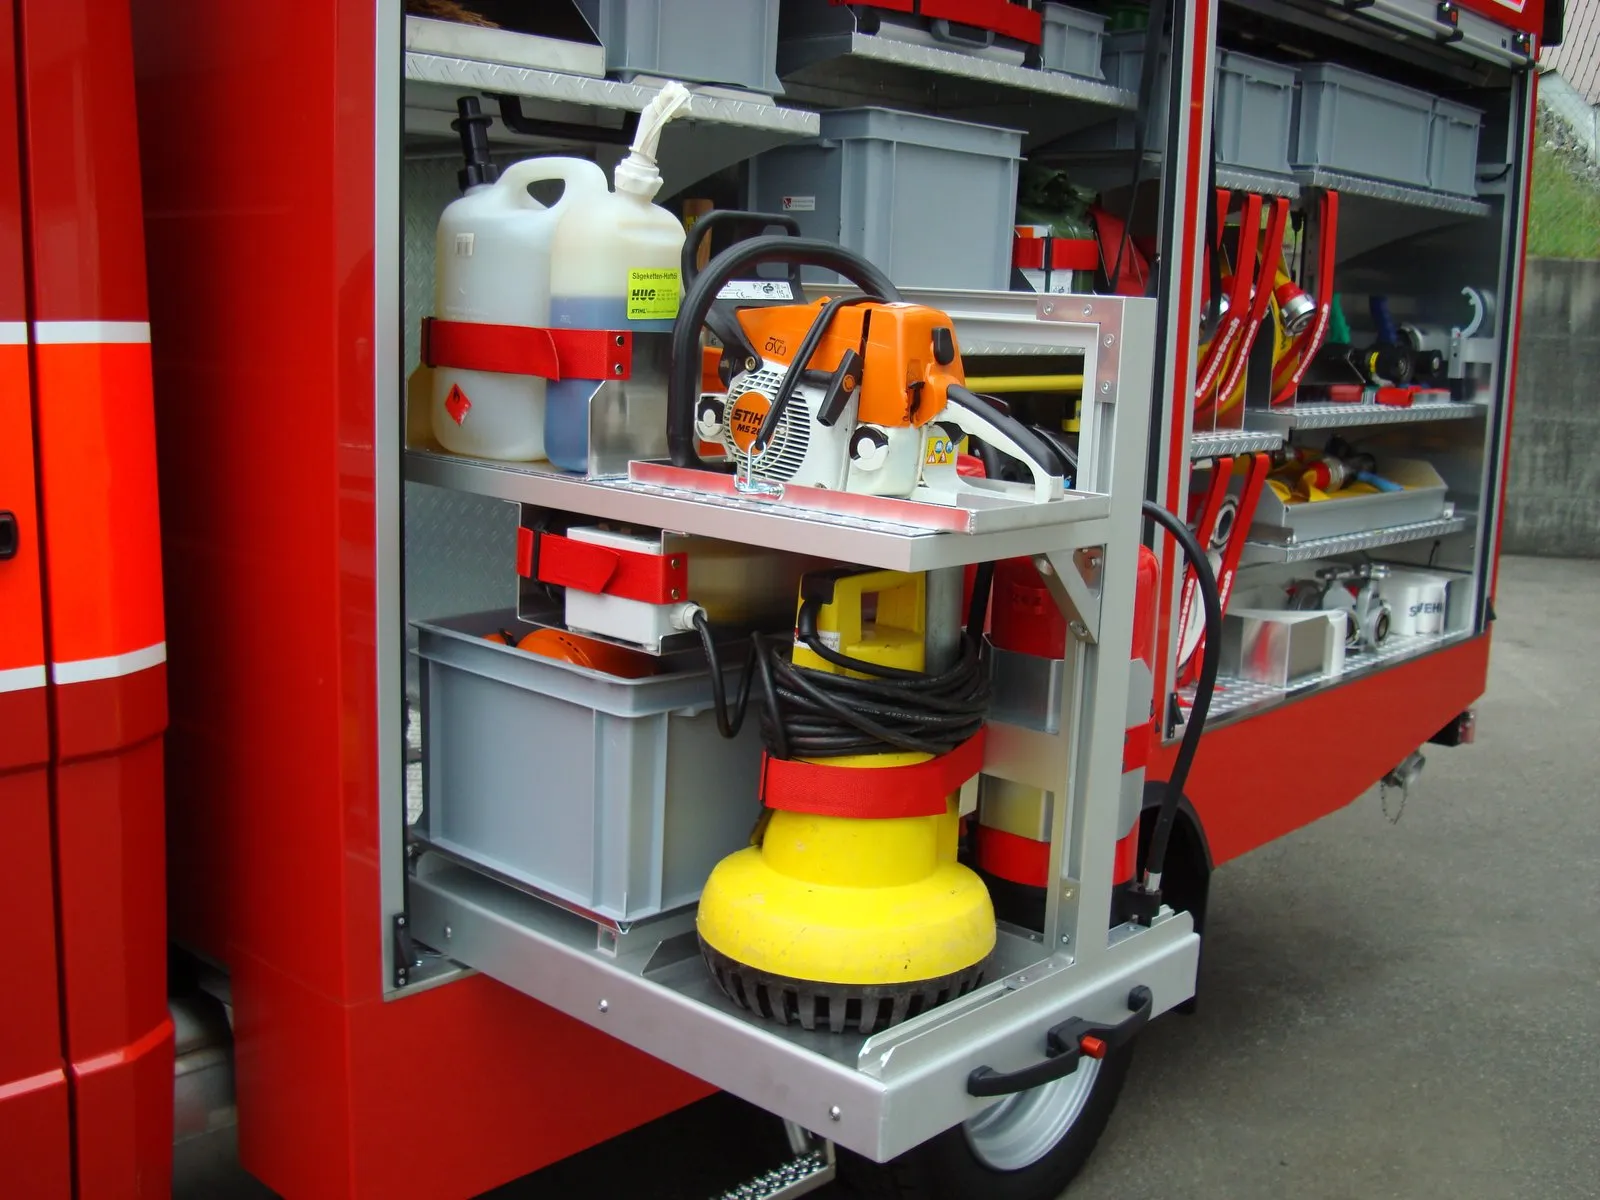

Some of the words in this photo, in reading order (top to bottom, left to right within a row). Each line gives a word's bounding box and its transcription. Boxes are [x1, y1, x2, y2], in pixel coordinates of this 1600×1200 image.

[632, 289, 656, 301] HUG
[732, 408, 763, 425] STIH
[736, 424, 751, 433] MS
